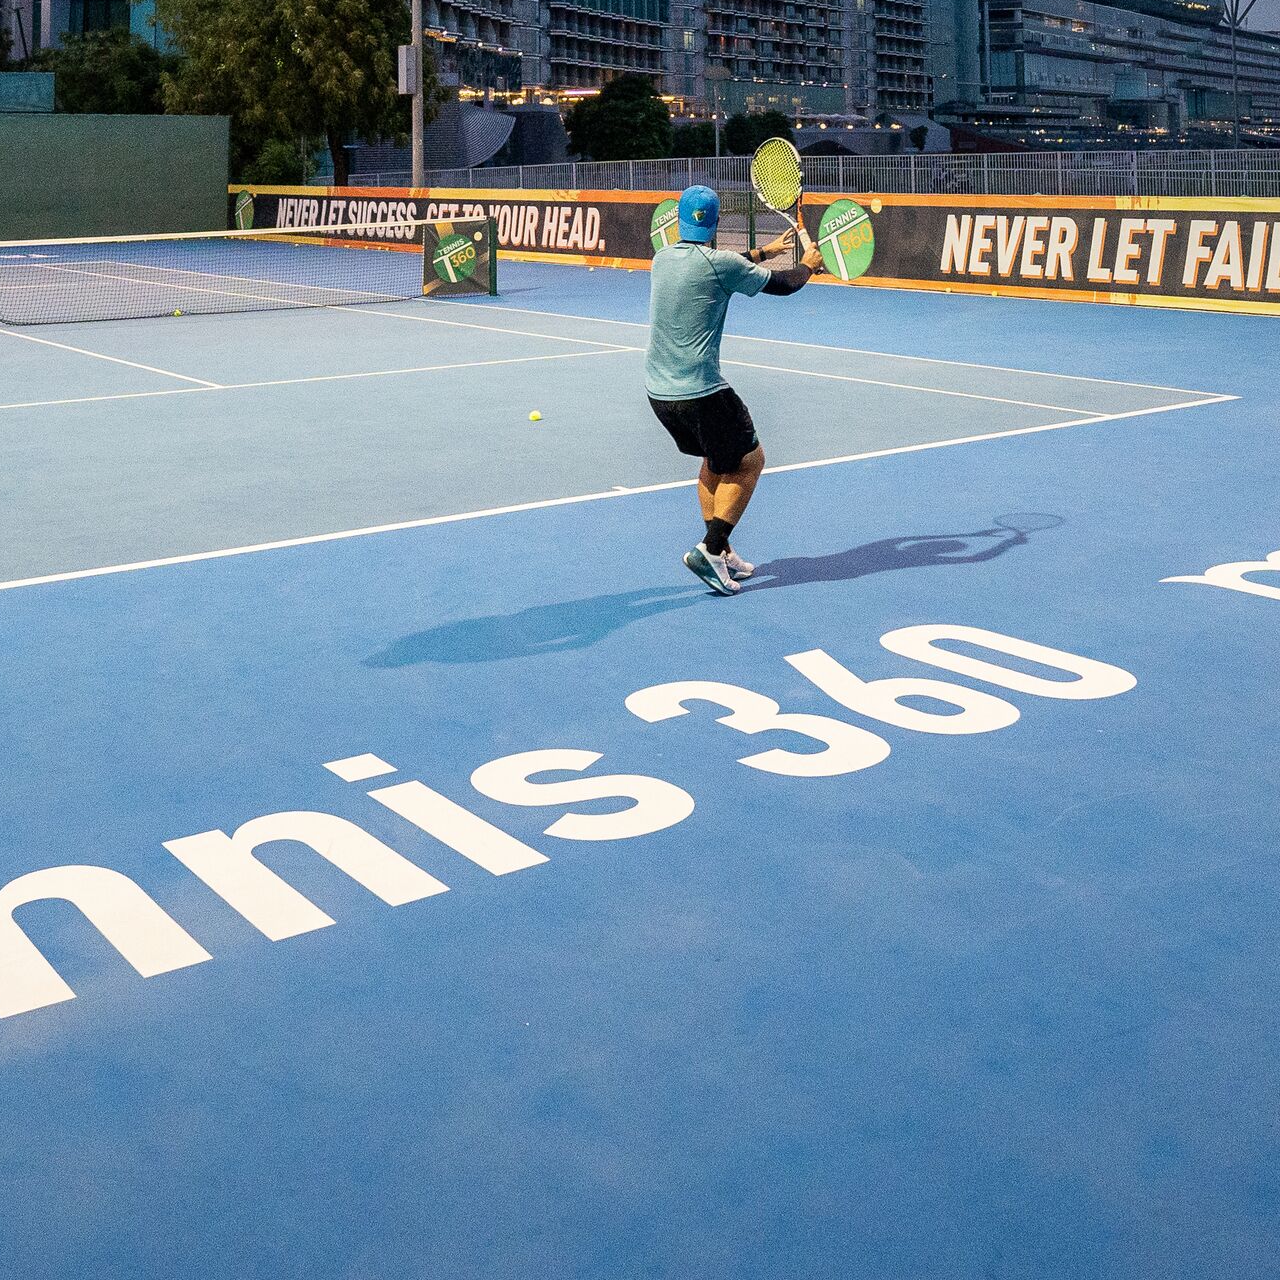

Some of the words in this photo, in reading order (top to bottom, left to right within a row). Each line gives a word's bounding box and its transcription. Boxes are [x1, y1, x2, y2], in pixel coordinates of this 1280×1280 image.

[276, 198, 319, 229] NEVER
[320, 200, 347, 234] LET
[348, 200, 417, 239] SUCCESS
[541, 206, 606, 251] HEAD.
[823, 207, 858, 233] TENNIS
[438, 238, 465, 256] TENNIS
[839, 223, 873, 255] 360
[940, 214, 1078, 281] NEVER
[1087, 218, 1178, 286] LET
[450, 246, 476, 268] 360
[625, 623, 1138, 776] 360
